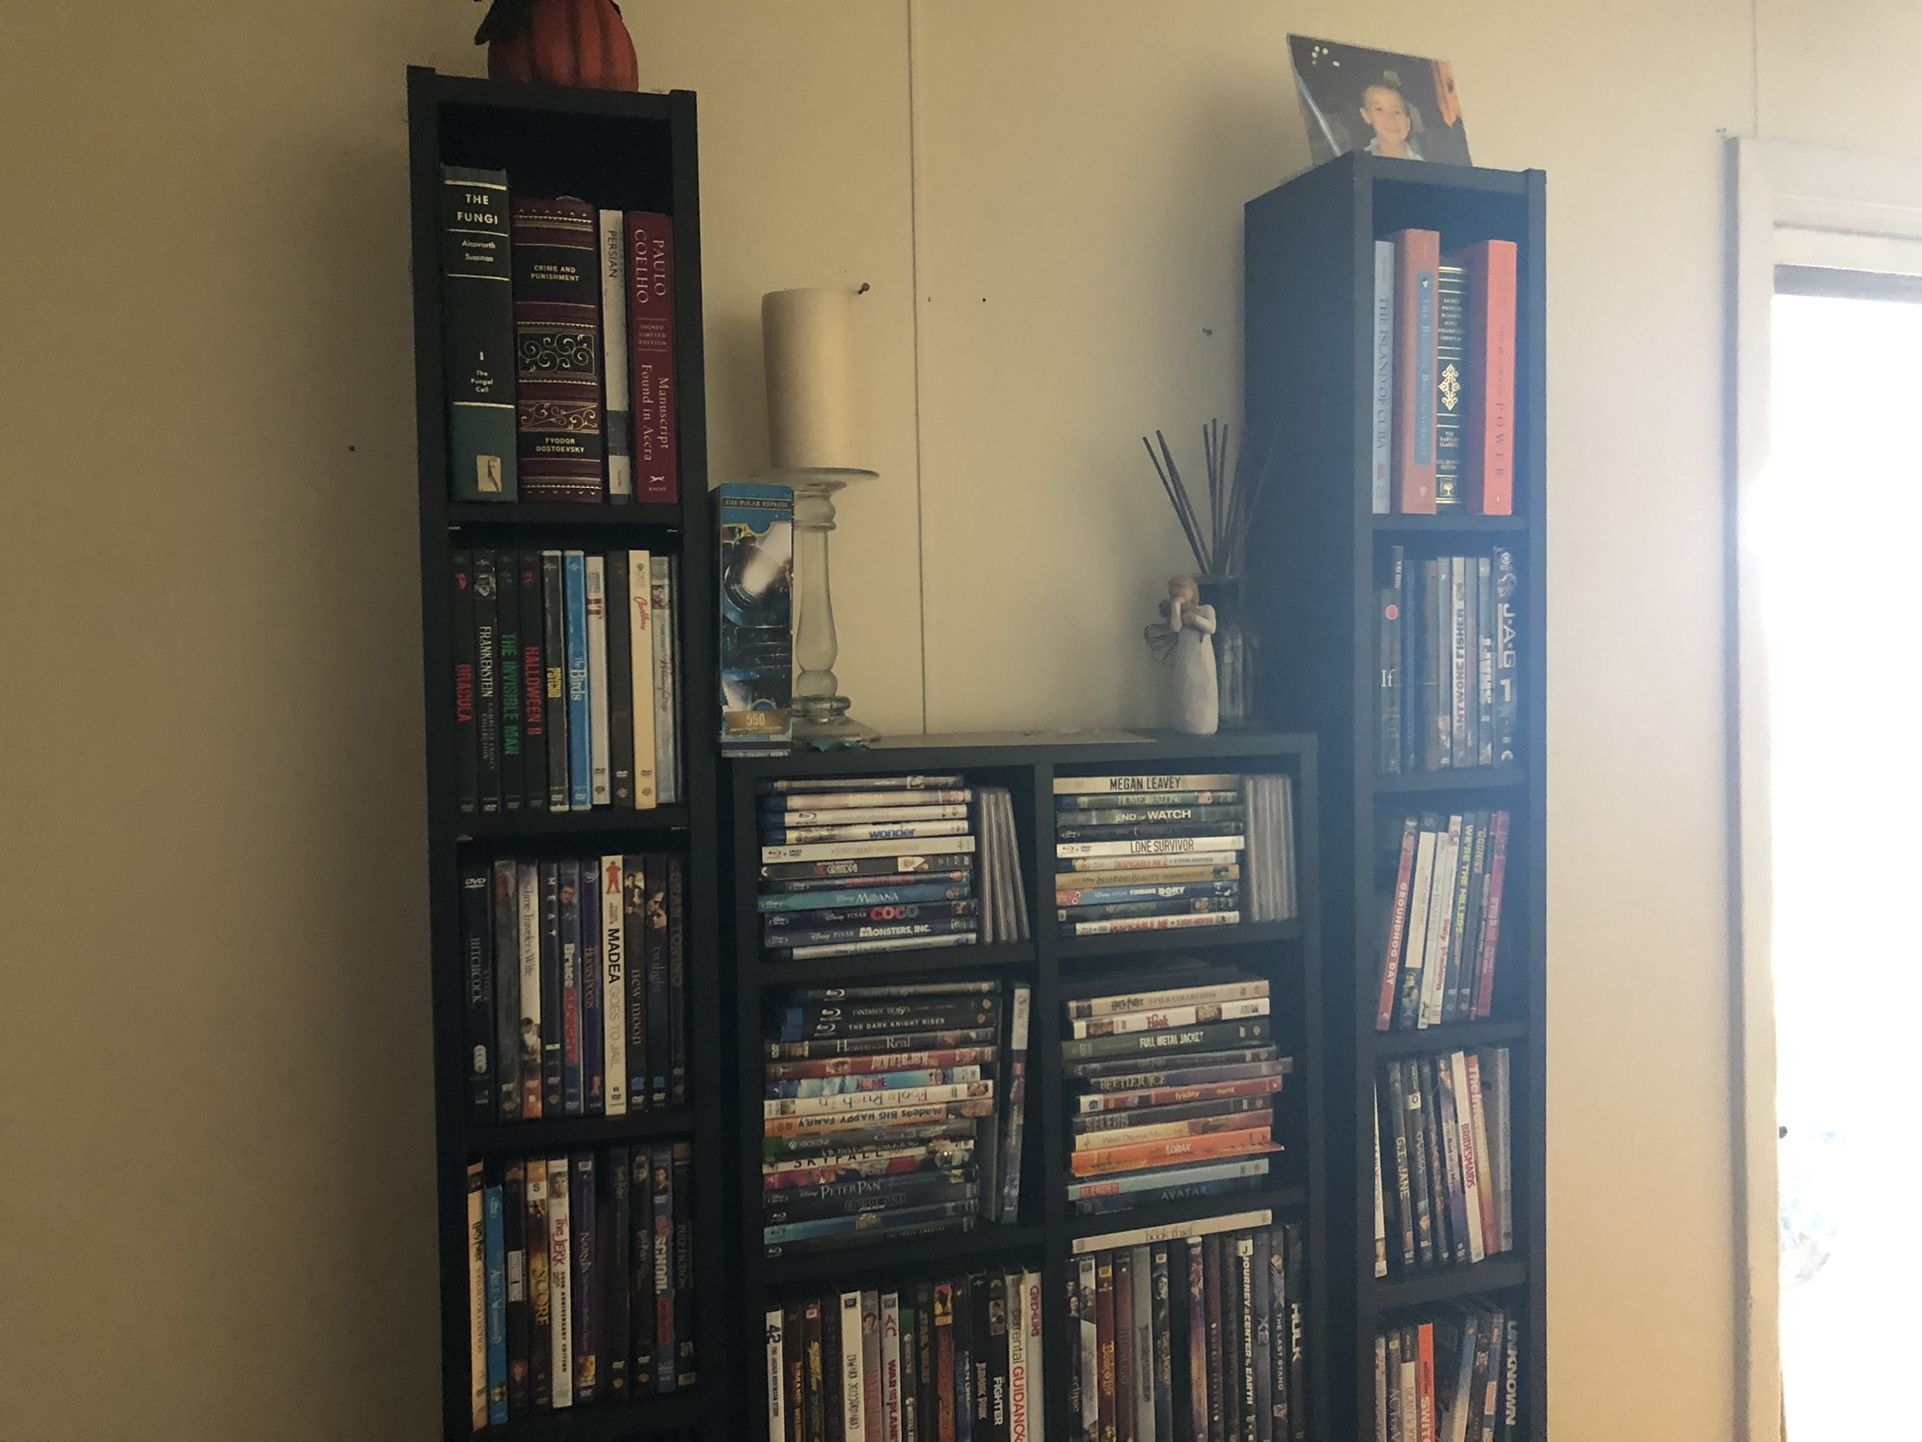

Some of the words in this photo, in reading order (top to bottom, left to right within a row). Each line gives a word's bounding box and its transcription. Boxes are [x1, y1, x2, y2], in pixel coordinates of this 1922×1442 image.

[465, 194, 489, 205] THE
[457, 211, 499, 225] FUNGI
[462, 240, 496, 249] Ainsworth
[607, 230, 618, 278] PERSIAN
[634, 229, 649, 304] COELHO
[653, 239, 666, 297] PAULO
[1378, 300, 1388, 323] THE
[1378, 330, 1388, 383] ISLAND
[476, 369, 488, 377] The
[641, 364, 654, 403] Found
[1378, 388, 1388, 405] OF
[643, 408, 652, 420] in
[658, 377, 670, 449] Manuscript
[643, 426, 654, 461] Accra
[1377, 409, 1387, 449] CUBA
[1494, 402, 1504, 479] POWER
[502, 634, 517, 656] THE
[1455, 607, 1464, 658] FISHER
[480, 626, 493, 698] FRANKENSTEIN
[456, 664, 472, 722] DRACULA
[502, 661, 518, 720] INVISIBLE
[525, 647, 542, 722] HALLOWEEN
[570, 669, 586, 700] Birds
[1456, 661, 1465, 732] ANTWONE
[504, 726, 520, 755] MAN
[1110, 778, 1143, 790] MEGAN
[1146, 777, 1181, 789] LEAVEY
[869, 825, 916, 838] wonder
[1116, 813, 1136, 822] END
[1147, 810, 1192, 820] WATCH
[1130, 841, 1152, 854] LONE
[1154, 839, 1194, 852] SURVIVOR
[1474, 831, 1484, 874] GOONIES
[1158, 886, 1186, 896] DORY
[1460, 865, 1468, 886] THE
[670, 872, 682, 918] GRAN
[857, 892, 899, 904] MOANA
[870, 905, 919, 921] COCO
[1390, 882, 1406, 957] GROUNDHOG
[860, 926, 913, 937] MONSTERS,
[914, 924, 931, 933] INC.
[472, 938, 482, 1002] HITCHCOCK
[564, 944, 575, 987] Bruce
[608, 928, 620, 984] MADEA
[650, 946, 664, 992] twilight
[630, 969, 642, 997] new
[1386, 962, 1396, 985] DAY
[610, 986, 620, 1020] GOES
[610, 1025, 620, 1042] TO
[631, 1002, 642, 1045] moon
[866, 1022, 888, 1030] DARK
[890, 1020, 919, 1028] KNIGHT
[922, 1018, 946, 1026] RISES
[610, 1044, 621, 1066] JAIL
[886, 1037, 911, 1049] Real
[1140, 1037, 1156, 1048] FULL
[1157, 1034, 1178, 1047] METAL
[1180, 1032, 1204, 1044] JACKET
[1100, 1074, 1166, 1090] BEETLEJUICE
[798, 1116, 836, 1128] FAMILY
[840, 1112, 876, 1124] HAPPY
[878, 1111, 898, 1120] BIG
[1166, 1143, 1192, 1156] LORAX
[1396, 1136, 1408, 1162] G.I.
[1461, 1122, 1475, 1188] BRIDESMAIDS
[820, 1184, 856, 1200] PETER
[857, 1181, 880, 1194] PAN
[1162, 1186, 1208, 1200] AVATAR
[1397, 1165, 1409, 1200] JANE
[554, 1216, 568, 1236] The
[678, 1224, 686, 1246] PULP
[552, 1234, 568, 1266] JERK
[654, 1236, 668, 1294] SCHOOL
[678, 1248, 688, 1289] FICTION
[1242, 1256, 1251, 1307] JOURNEY
[532, 1269, 549, 1325] SCORE
[1030, 1285, 1040, 1337] GREMLINS
[766, 1325, 781, 1344] 42
[1011, 1310, 1024, 1363] parental
[1244, 1315, 1252, 1360] CENTER
[1292, 1304, 1302, 1362] HULK
[888, 1359, 896, 1388] WAR
[1246, 1367, 1254, 1404] EARTH
[1505, 1320, 1518, 1426] UNKNOWN
[994, 1376, 1003, 1426] FIGHTER
[1070, 1376, 1082, 1412] eclipse
[1389, 1388, 1400, 1417] ACT
